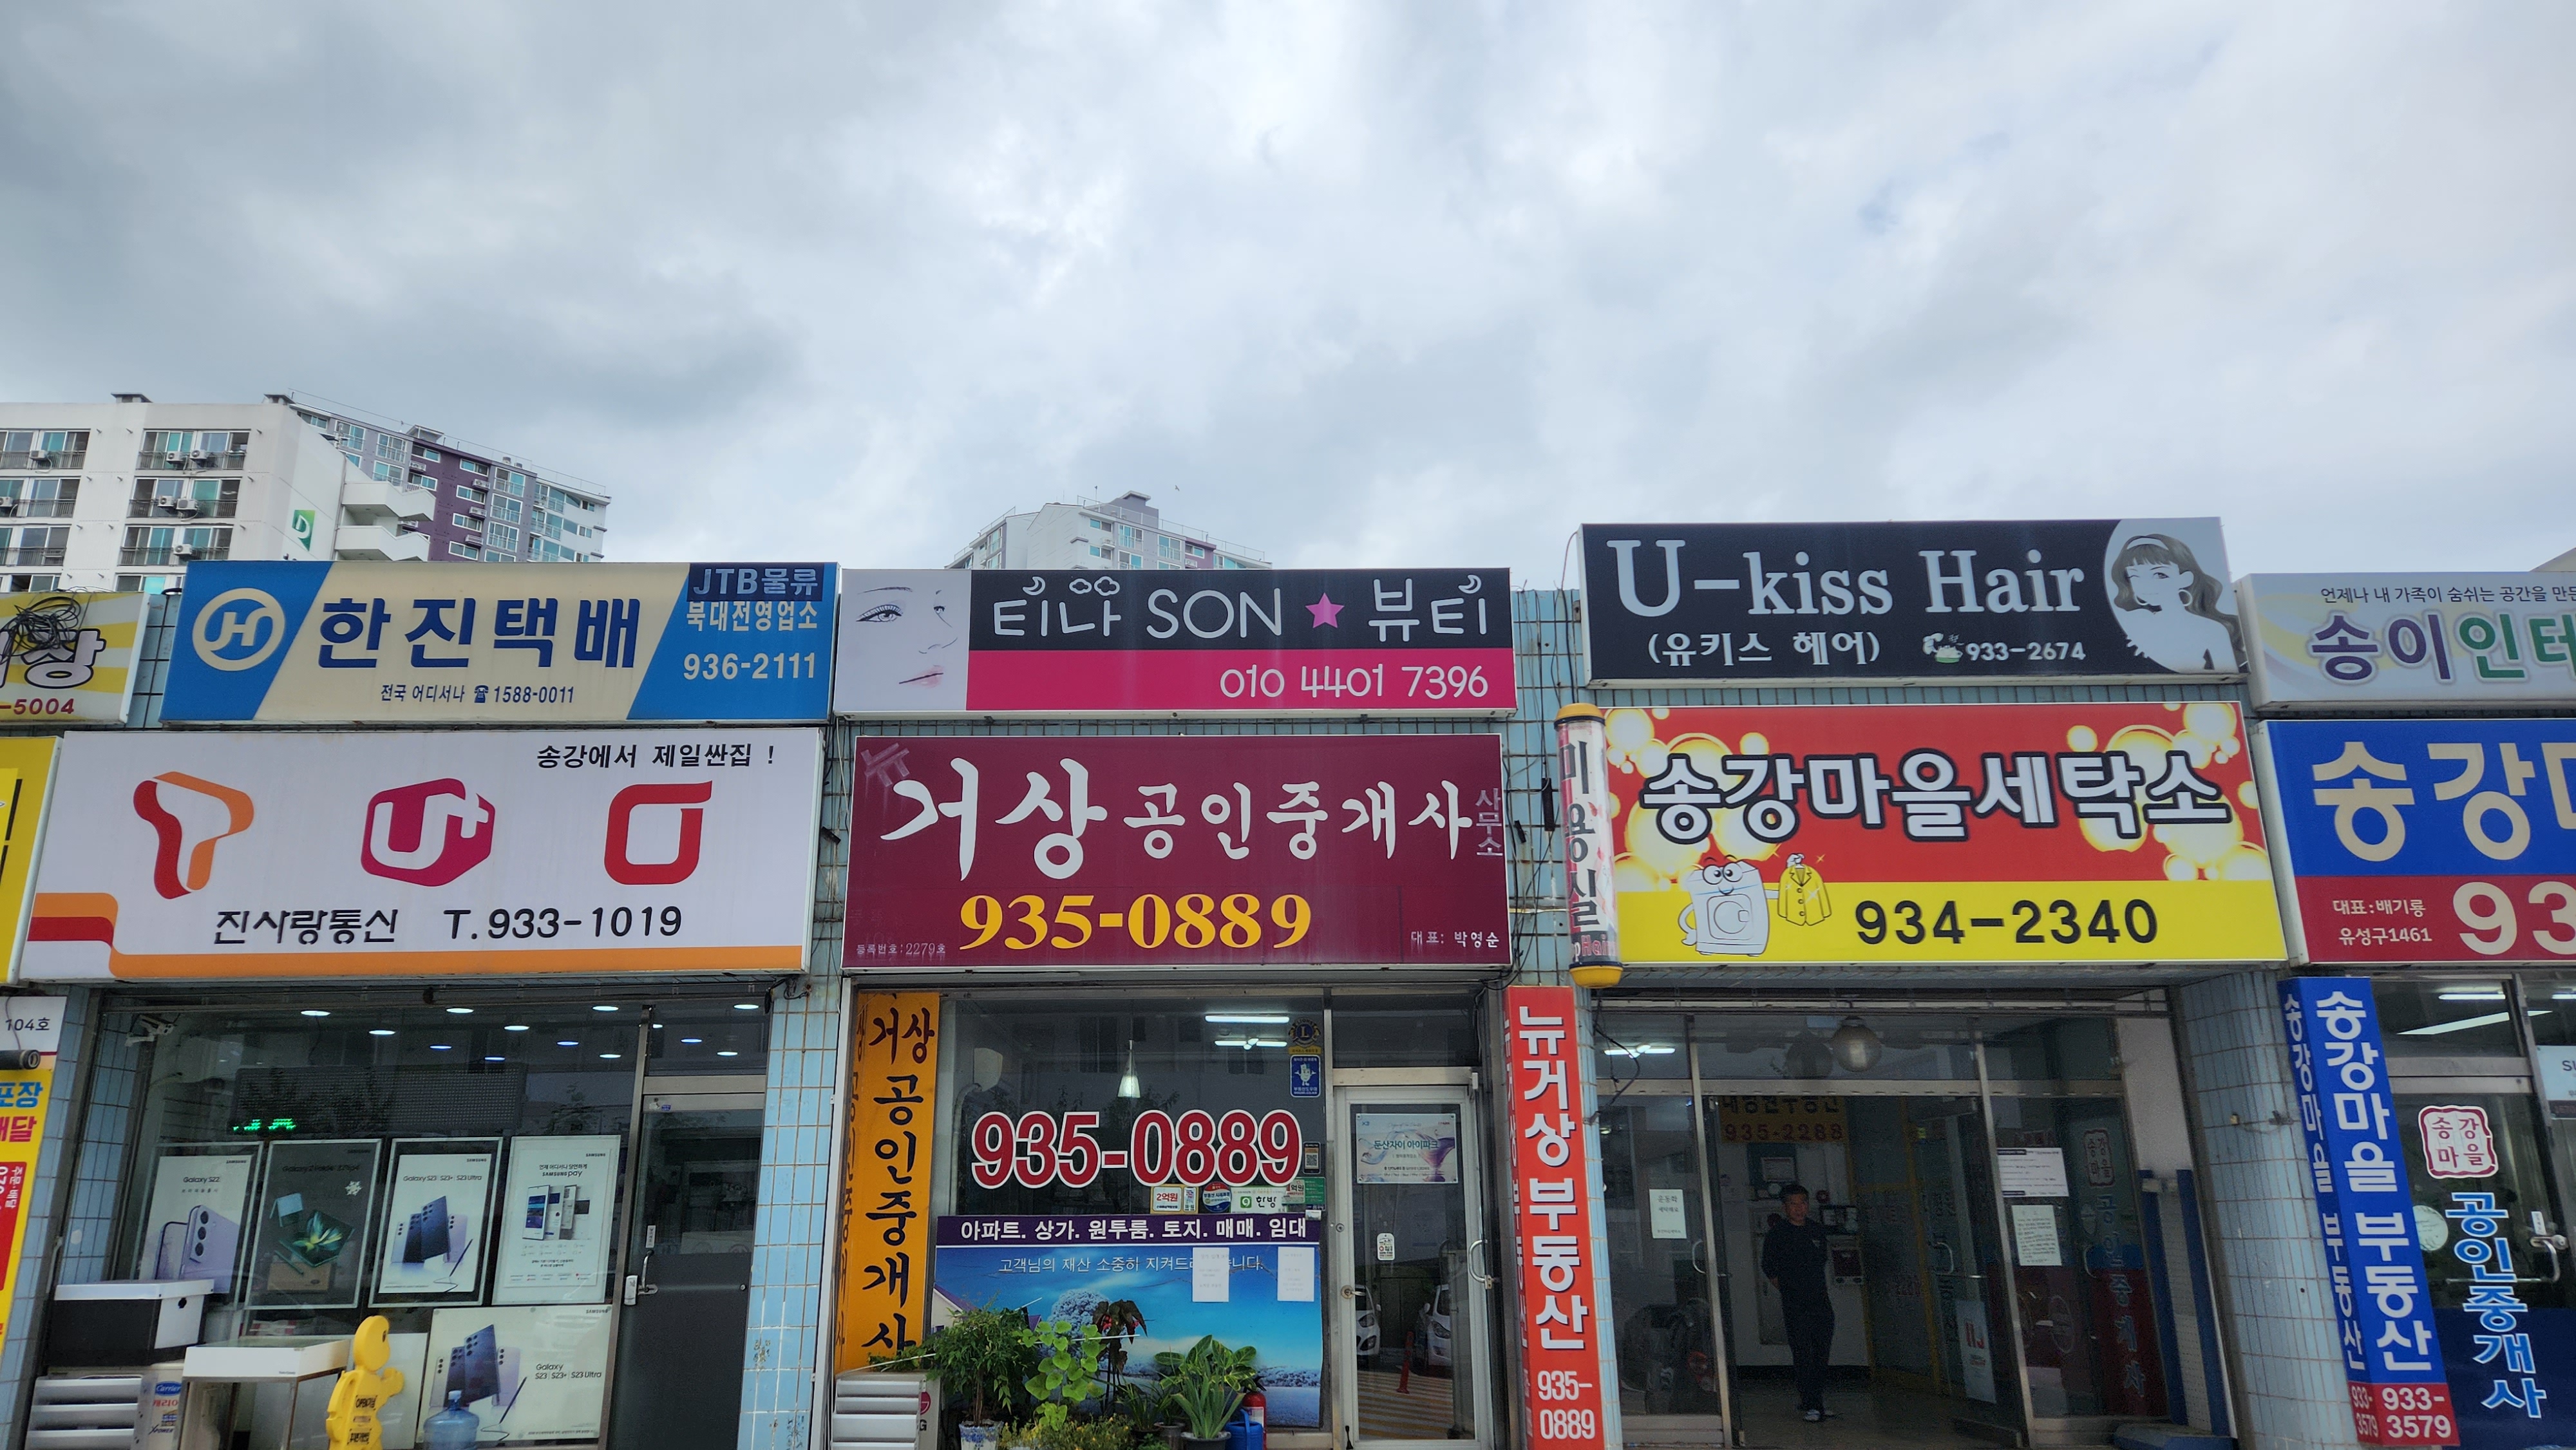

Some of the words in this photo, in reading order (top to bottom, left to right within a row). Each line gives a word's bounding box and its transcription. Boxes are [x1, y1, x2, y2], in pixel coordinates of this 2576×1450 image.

[692, 567, 819, 596] JTB물류
[1607, 539, 1893, 617] U-kiss
[1917, 549, 2083, 614] Hair
[2320, 587, 2369, 604] 언제나
[2374, 587, 2390, 603] 내
[2395, 587, 2443, 603] 가족이
[2447, 587, 2495, 603] 숨쉬는
[2499, 586, 2546, 603] 공간을
[685, 601, 819, 632] 북대전영업소
[1146, 587, 1282, 639] SON
[317, 596, 641, 670] 한진택배
[1647, 630, 1773, 667] (유키스
[1792, 630, 1880, 666] 헤어)
[683, 652, 817, 681] 936-2111
[1966, 642, 2087, 661] 933-2674
[380, 684, 406, 703] 전국
[412, 685, 466, 704] 어디서나
[494, 686, 574, 704] 1588-0011
[1220, 664, 1285, 699] 010
[1300, 664, 1385, 699] 4401
[1401, 664, 1489, 699] 7396
[537, 744, 637, 768] 송강에서
[652, 744, 752, 767] 제일싼집
[1639, 746, 2233, 845] 송강마을세탁소
[880, 757, 1108, 881] 거상
[1123, 780, 1473, 860] 공인중개사
[1475, 787, 1502, 856] 사무소
[1560, 740, 1600, 928] 미용실
[213, 909, 399, 945] 진사랑통신
[959, 893, 1312, 950] 935-0889
[1855, 899, 2158, 945] 934-2340
[2338, 927, 2432, 946] 유성구1461
[1454, 931, 1501, 948] 박영순
[5, 1017, 51, 1031] 104호
[868, 1007, 935, 1066] 거상
[1520, 1006, 1576, 1167] 뉴거상
[2316, 991, 2397, 1192] 송강마을
[971, 1109, 1302, 1189] 935-0889
[1374, 1140, 1405, 1150] 둔산자이
[1156, 1192, 1178, 1202] 2억원
[1256, 1196, 1277, 1208] 한방
[960, 1222, 1026, 1241] 아파트.
[1034, 1221, 1079, 1239] 상가.
[1087, 1219, 1153, 1239] 원투룸.
[1162, 1218, 1207, 1238] 토지.
[1216, 1218, 1260, 1238] 매매.
[1269, 1217, 1307, 1238] 임대
[998, 1258, 1056, 1273] 고객님의
[1062, 1257, 1091, 1272] 재산
[1529, 1178, 1589, 1350] 부동산
[2356, 1212, 2432, 1372] 부동산
[2445, 1191, 2547, 1419] 공인중개사
[1537, 1371, 1593, 1401] 935-
[2382, 1387, 2445, 1411] 933-
[1540, 1409, 1595, 1440] 0889
[2356, 1413, 2378, 1438] 3579
[2386, 1416, 2452, 1438] 3579
